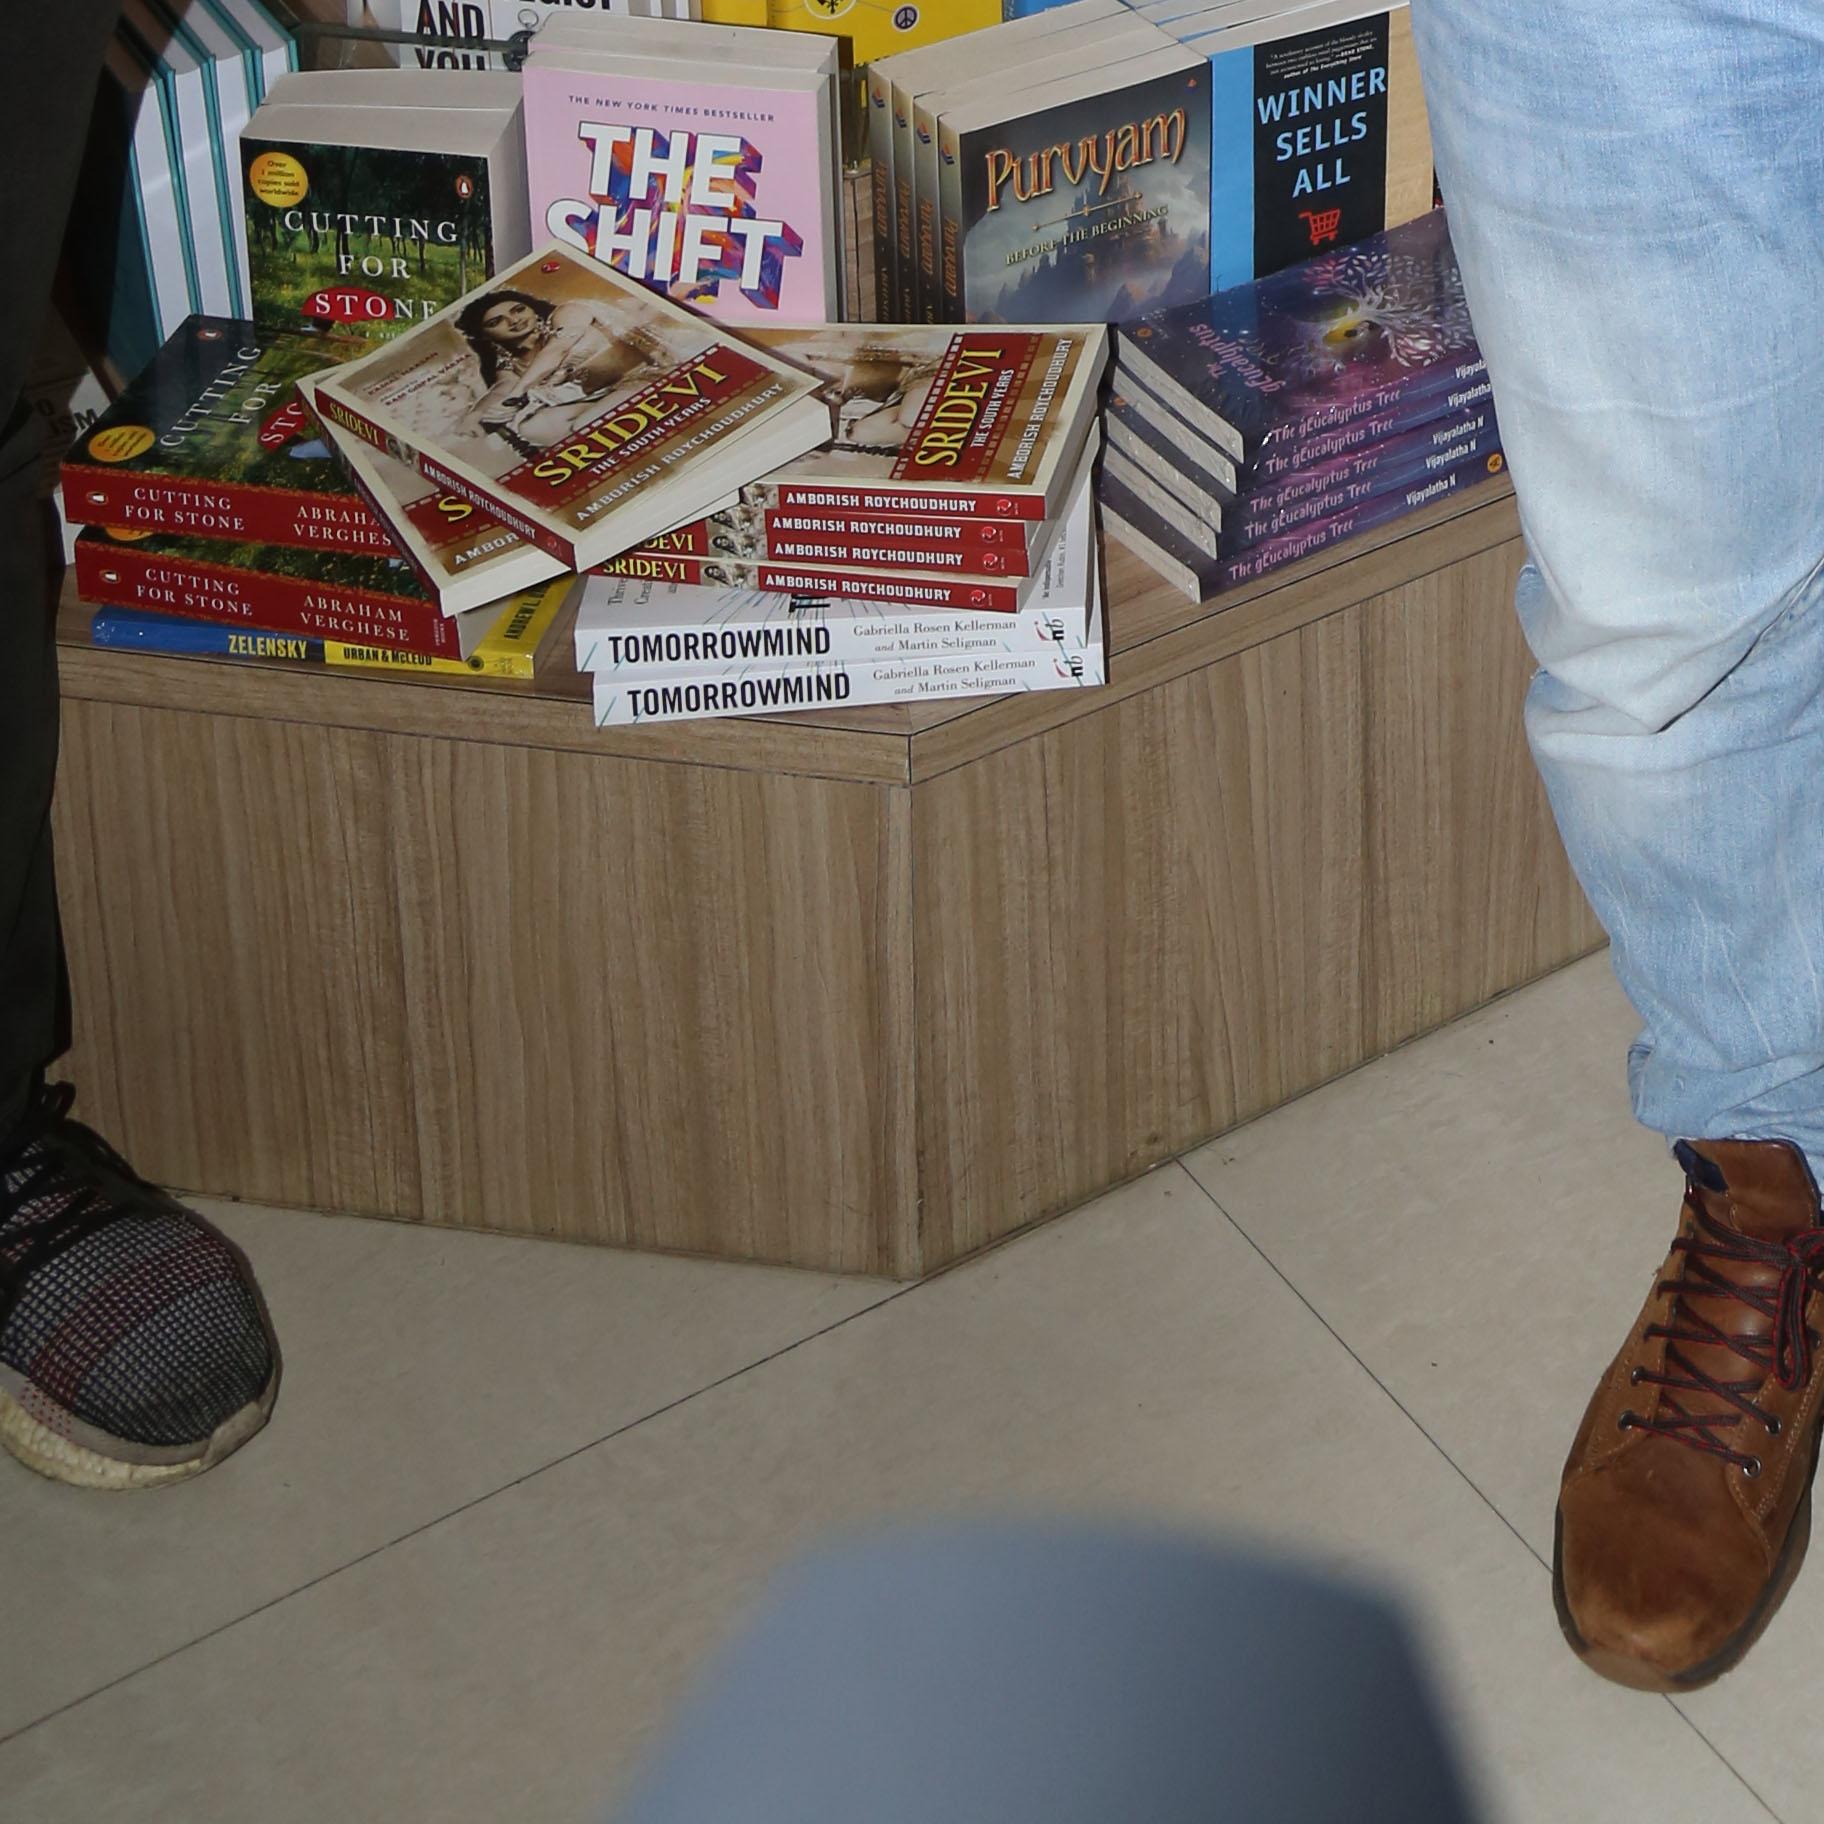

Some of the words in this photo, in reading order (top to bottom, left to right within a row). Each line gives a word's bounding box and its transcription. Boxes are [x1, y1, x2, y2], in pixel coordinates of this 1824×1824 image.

[568, 94, 591, 106] THE
[595, 97, 623, 109] NEW
[627, 100, 659, 112] YORK
[663, 104, 699, 116] TIMES
[703, 108, 776, 123] BESTSELLER
[1256, 66, 1387, 126] WINNER
[1276, 110, 1368, 162] SELLS
[578, 120, 754, 214] THE
[985, 107, 1186, 213] Purvyam
[1291, 158, 1351, 199] ALL
[284, 209, 458, 243] CUTTING
[1005, 237, 1058, 267] BEFORE
[1062, 227, 1088, 247] THE
[1091, 204, 1170, 238] BEGINNING
[546, 197, 794, 297] SHIFT
[339, 253, 411, 280] FOR
[532, 361, 729, 488] SRIDEVI
[592, 456, 618, 477] THE
[618, 426, 666, 458] SOUTH
[663, 397, 712, 428] YEARS
[576, 463, 662, 522] AMBORISH
[661, 381, 785, 466] ROYCHOUDHURY
[785, 490, 860, 508] AMBORISH
[864, 495, 977, 513] ROYCHOUDHURY
[1228, 560, 1253, 581] The
[1255, 531, 1328, 575] gEucalyptus
[1330, 518, 1355, 537] Tree
[1448, 473, 1457, 488] N
[137, 584, 176, 603] FOR
[185, 592, 253, 617] STONE
[144, 568, 240, 596] CUTTING
[300, 611, 411, 642] VERGHESE
[302, 594, 403, 623] ABRAHAM
[227, 634, 308, 661] ZELENSKY
[608, 626, 832, 664] TOMORROWMIND
[853, 622, 910, 638] Gabriella
[914, 620, 952, 634] Rosen
[953, 619, 1017, 633] Kellerman
[874, 640, 895, 653] and
[898, 637, 938, 652] Martin
[941, 636, 997, 652] Seligman
